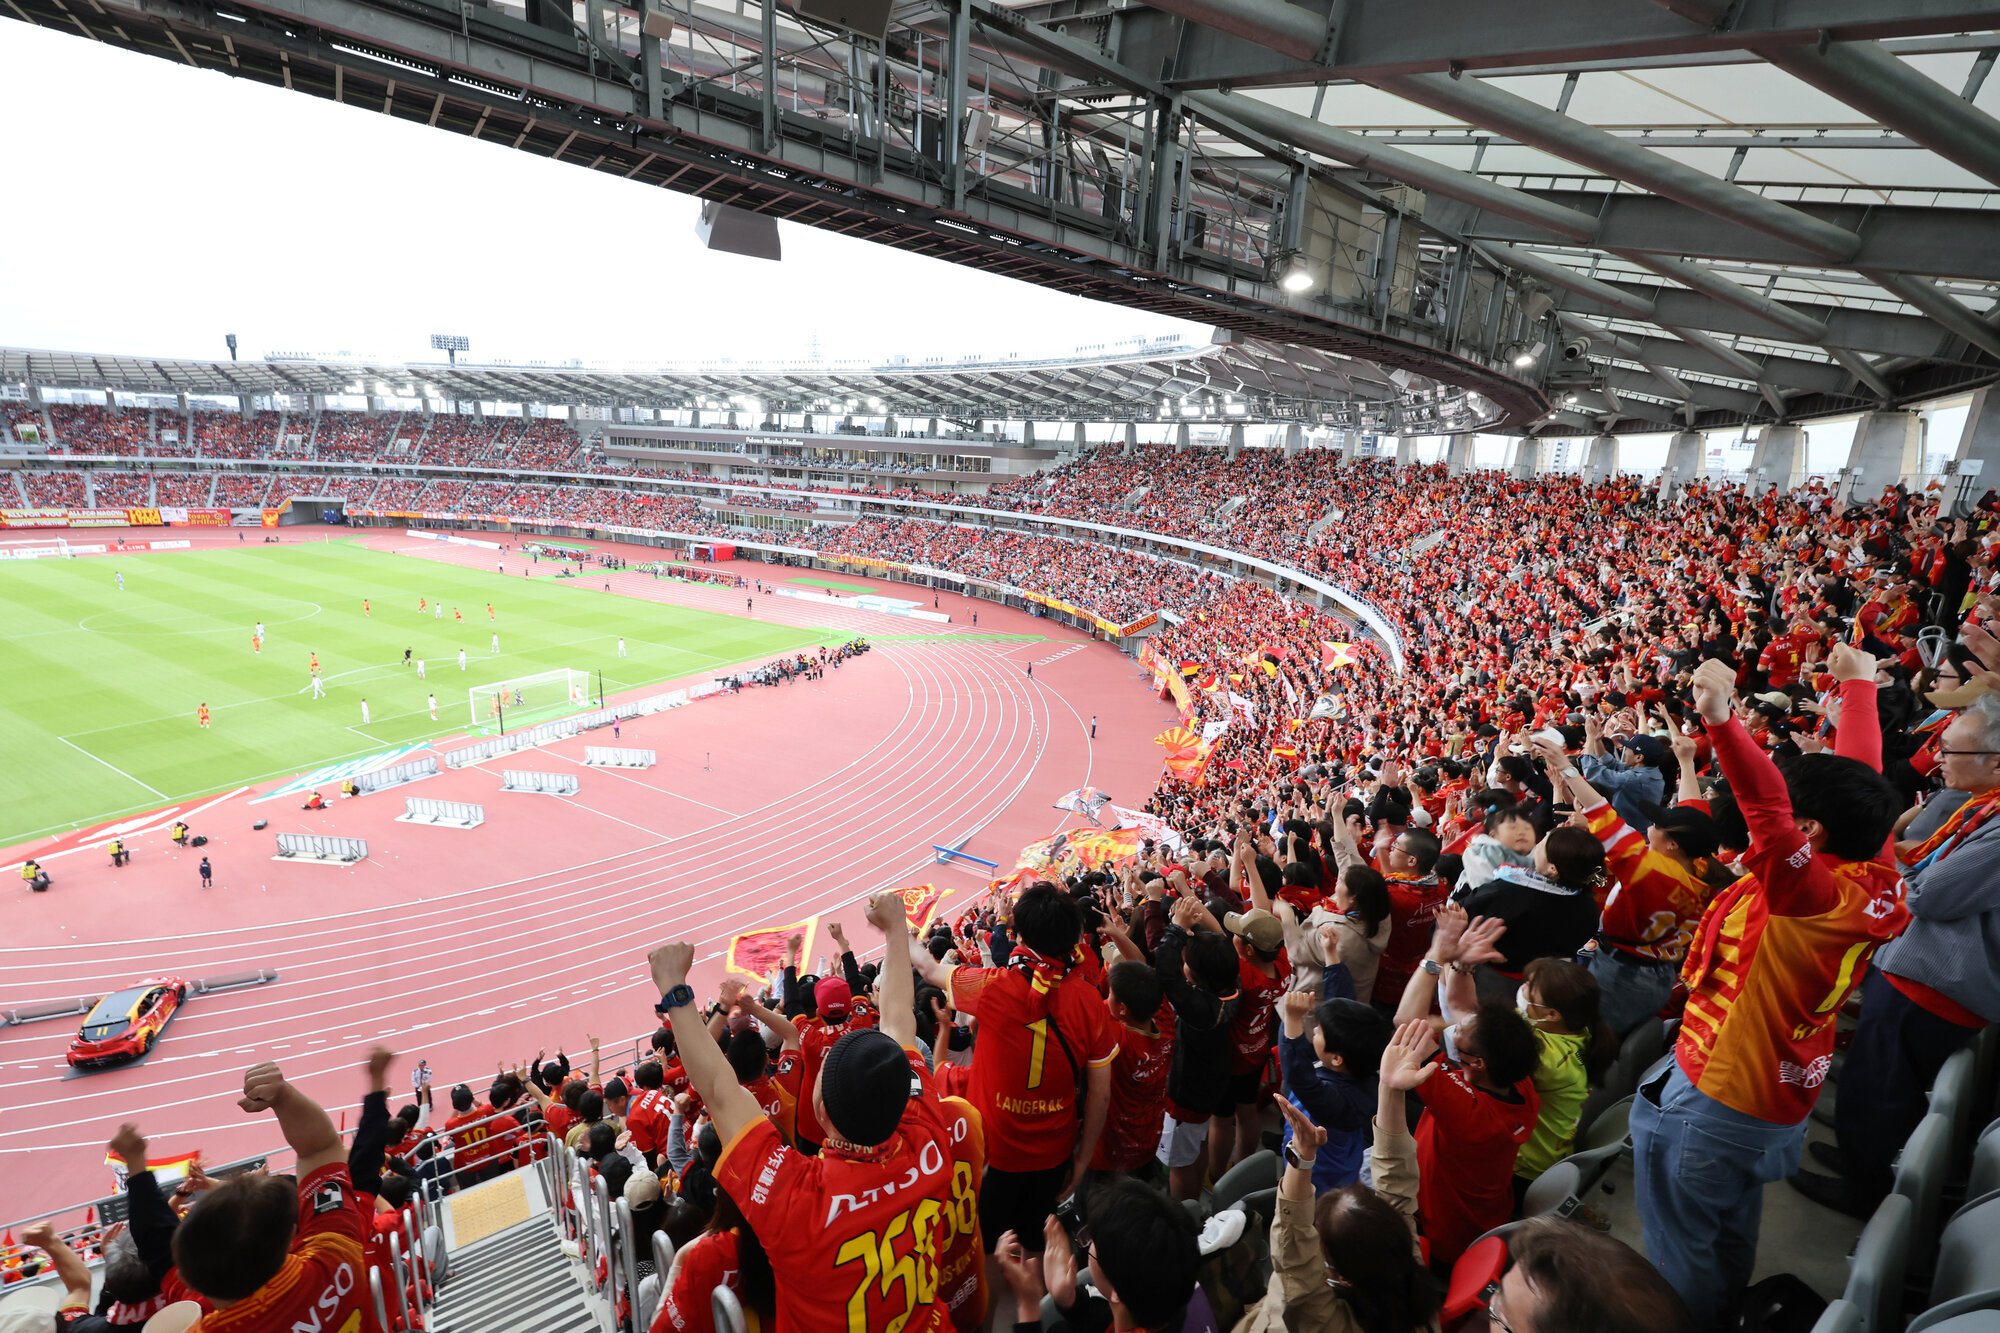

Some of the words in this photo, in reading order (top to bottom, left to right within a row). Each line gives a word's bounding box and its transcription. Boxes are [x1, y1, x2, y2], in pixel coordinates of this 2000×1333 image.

[783, 438, 804, 446] Stadium
[1024, 1017, 1048, 1089] 1
[995, 1091, 1065, 1115] LANGERAK
[290, 1262, 354, 1333] NSO
